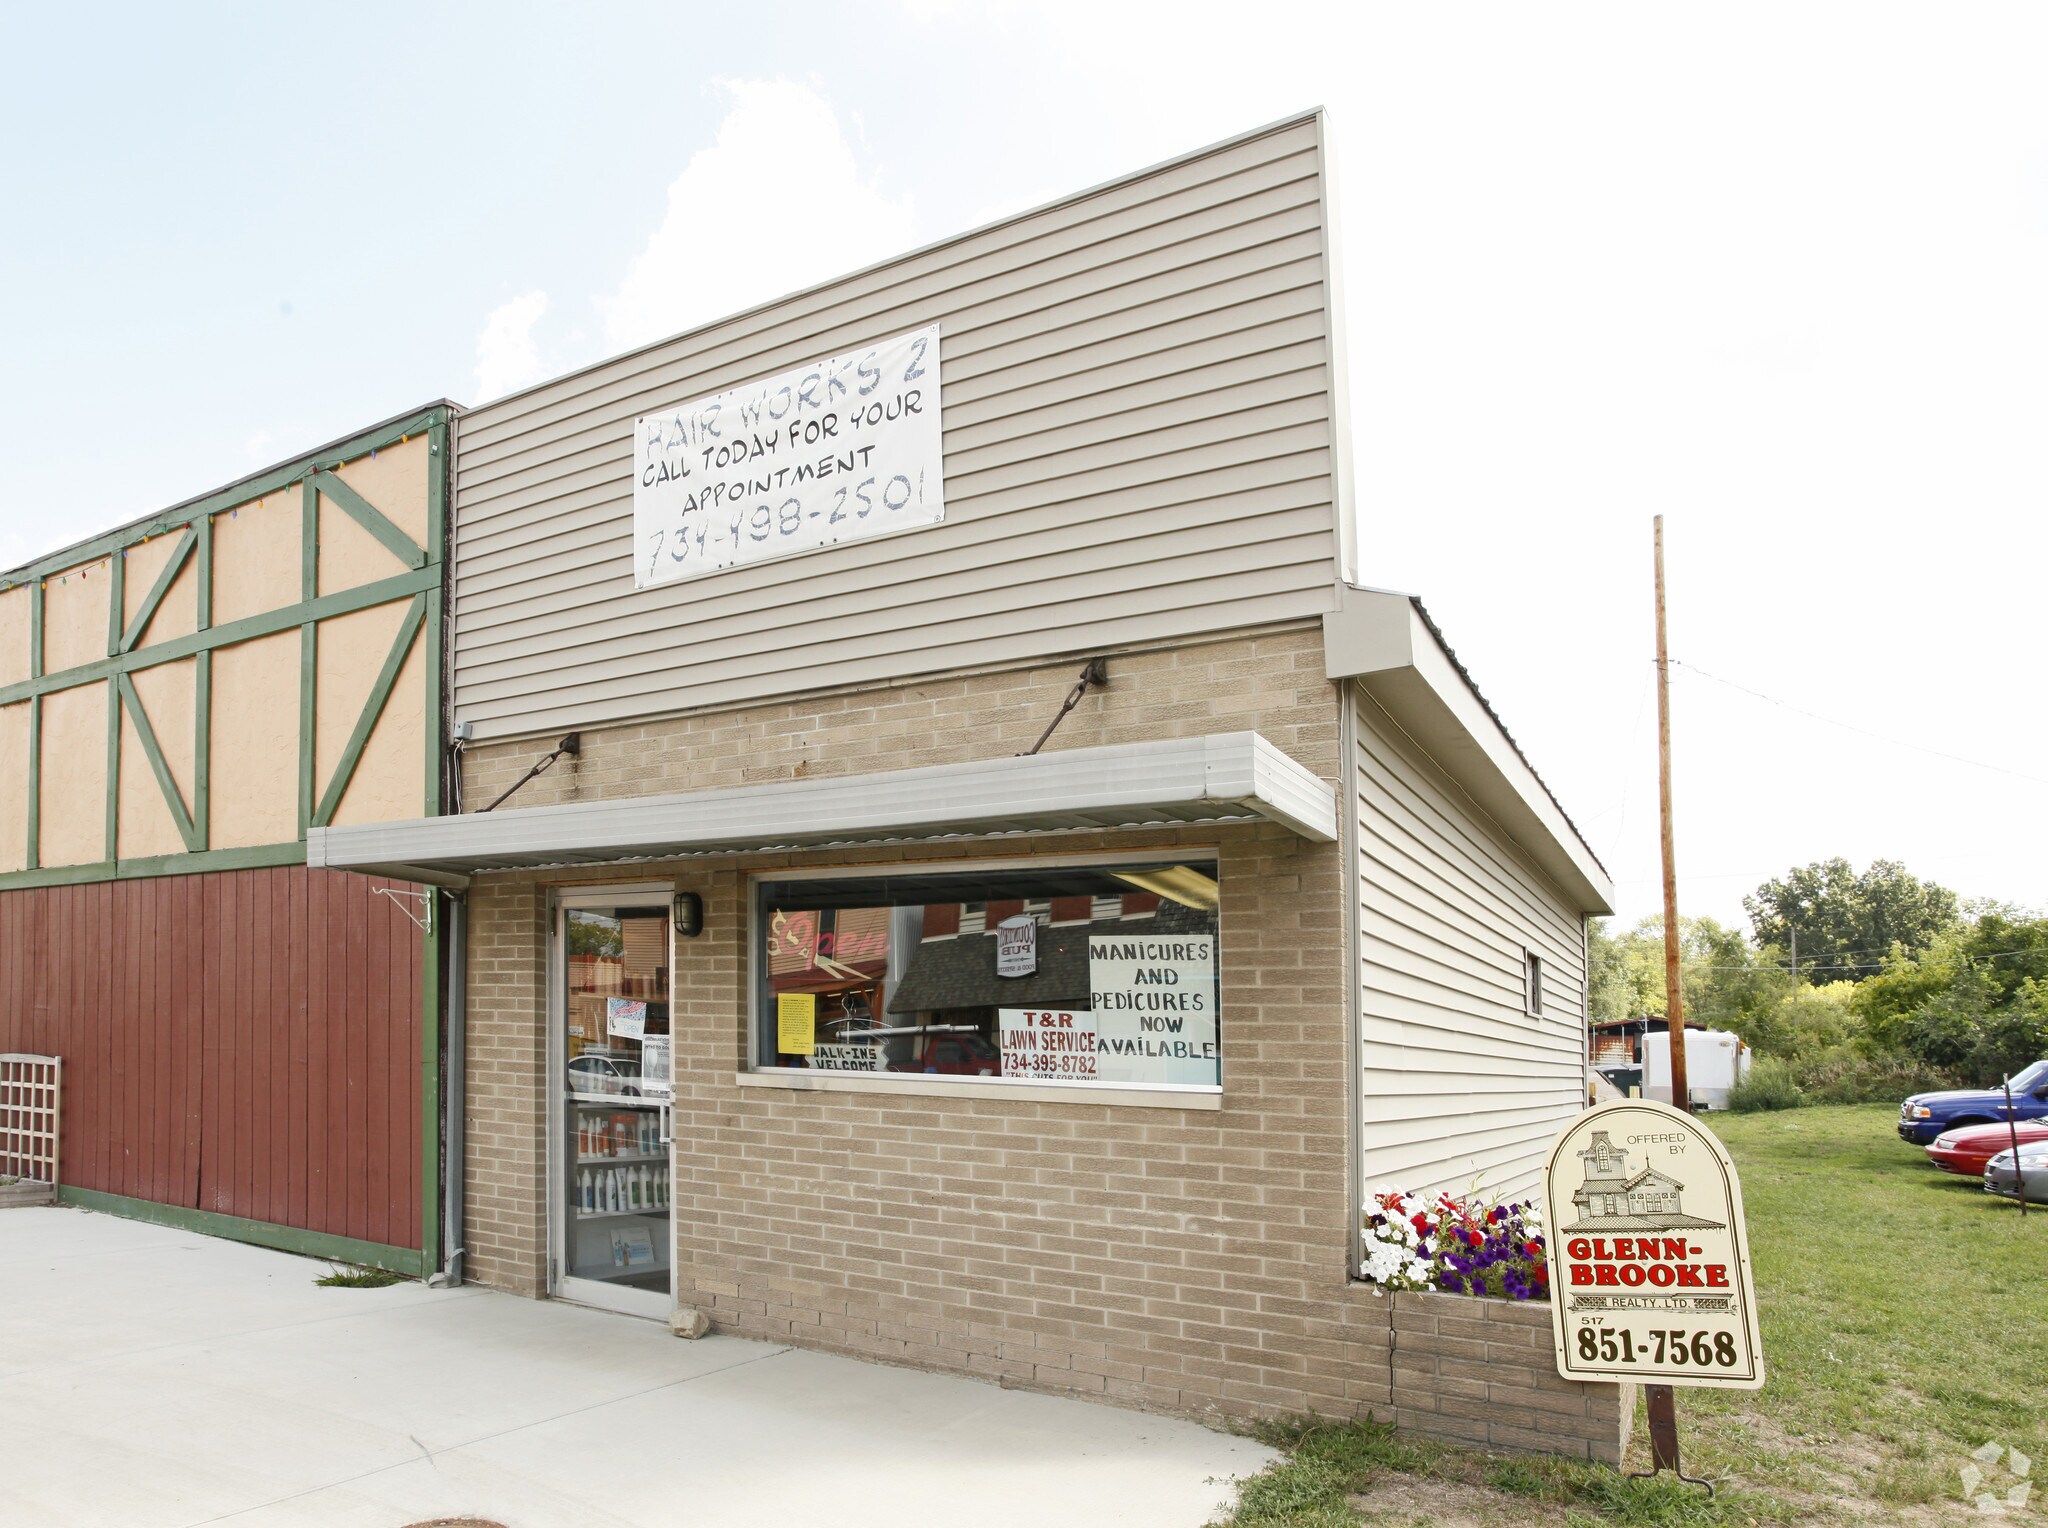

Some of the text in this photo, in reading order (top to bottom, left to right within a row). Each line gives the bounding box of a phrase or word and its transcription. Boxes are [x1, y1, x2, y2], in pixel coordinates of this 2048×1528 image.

[647, 337, 929, 459] HAIR WORKS 2
[642, 389, 923, 488] CALL TODAY FOR YOUR
[681, 445, 876, 517] APPOINTMENT
[649, 464, 926, 578] 734-498-2501
[778, 910, 890, 971] Open
[1134, 968, 1179, 985] AND
[1140, 1016, 1184, 1033] NOW
[1001, 1029, 1096, 1052] LAWN SERVICE
[1002, 1052, 1097, 1074] 734-395-8782
[1626, 1132, 1686, 1145] OFFERED
[1669, 1144, 1687, 1155] BY
[1567, 1237, 1703, 1261] GLENN-
[1570, 1263, 1730, 1288] BROOKE
[1665, 1299, 1691, 1309] LTD.
[1581, 1316, 1604, 1325] 517
[1577, 1327, 1737, 1367] 851-7568
